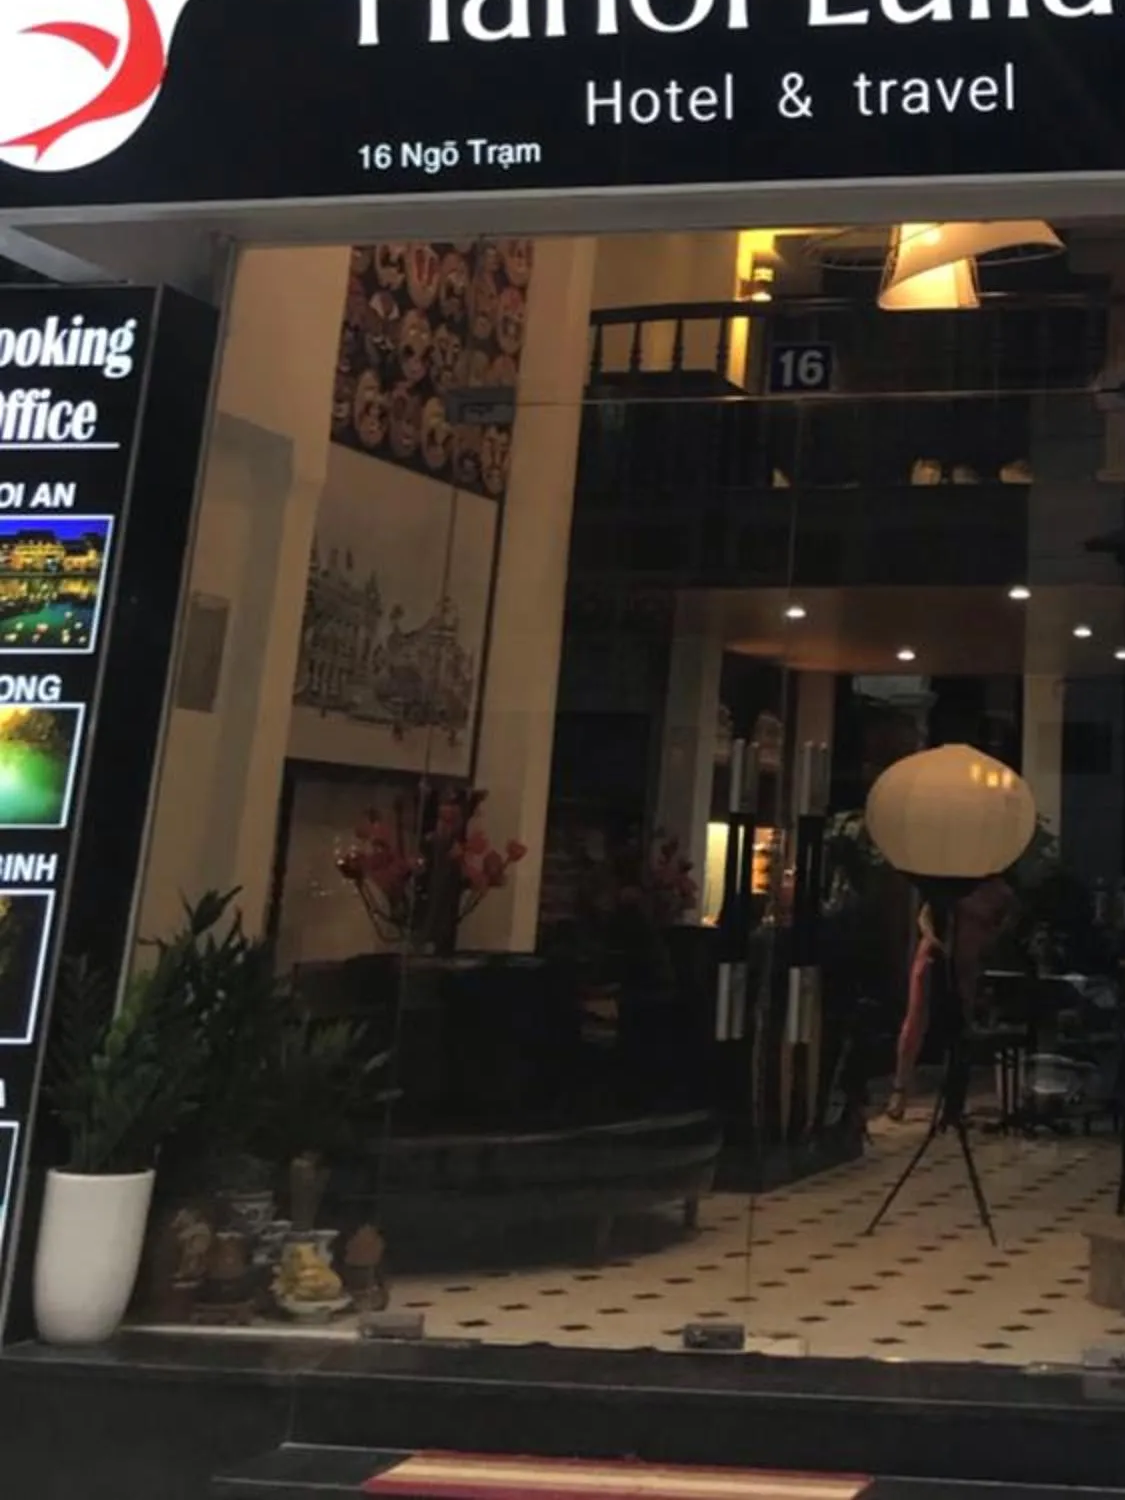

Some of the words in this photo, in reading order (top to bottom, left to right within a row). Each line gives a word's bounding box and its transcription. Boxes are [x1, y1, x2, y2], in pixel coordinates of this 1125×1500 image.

[587, 73, 733, 125] Hotel
[778, 72, 814, 118] &
[854, 63, 1014, 116] travel
[358, 144, 392, 170] 16
[401, 141, 460, 175] Ngõ
[467, 138, 542, 170] Trạm
[779, 349, 825, 387] 16
[0, 388, 98, 441] ffice
[29, 482, 76, 508] AN
[0, 853, 58, 882] INH
